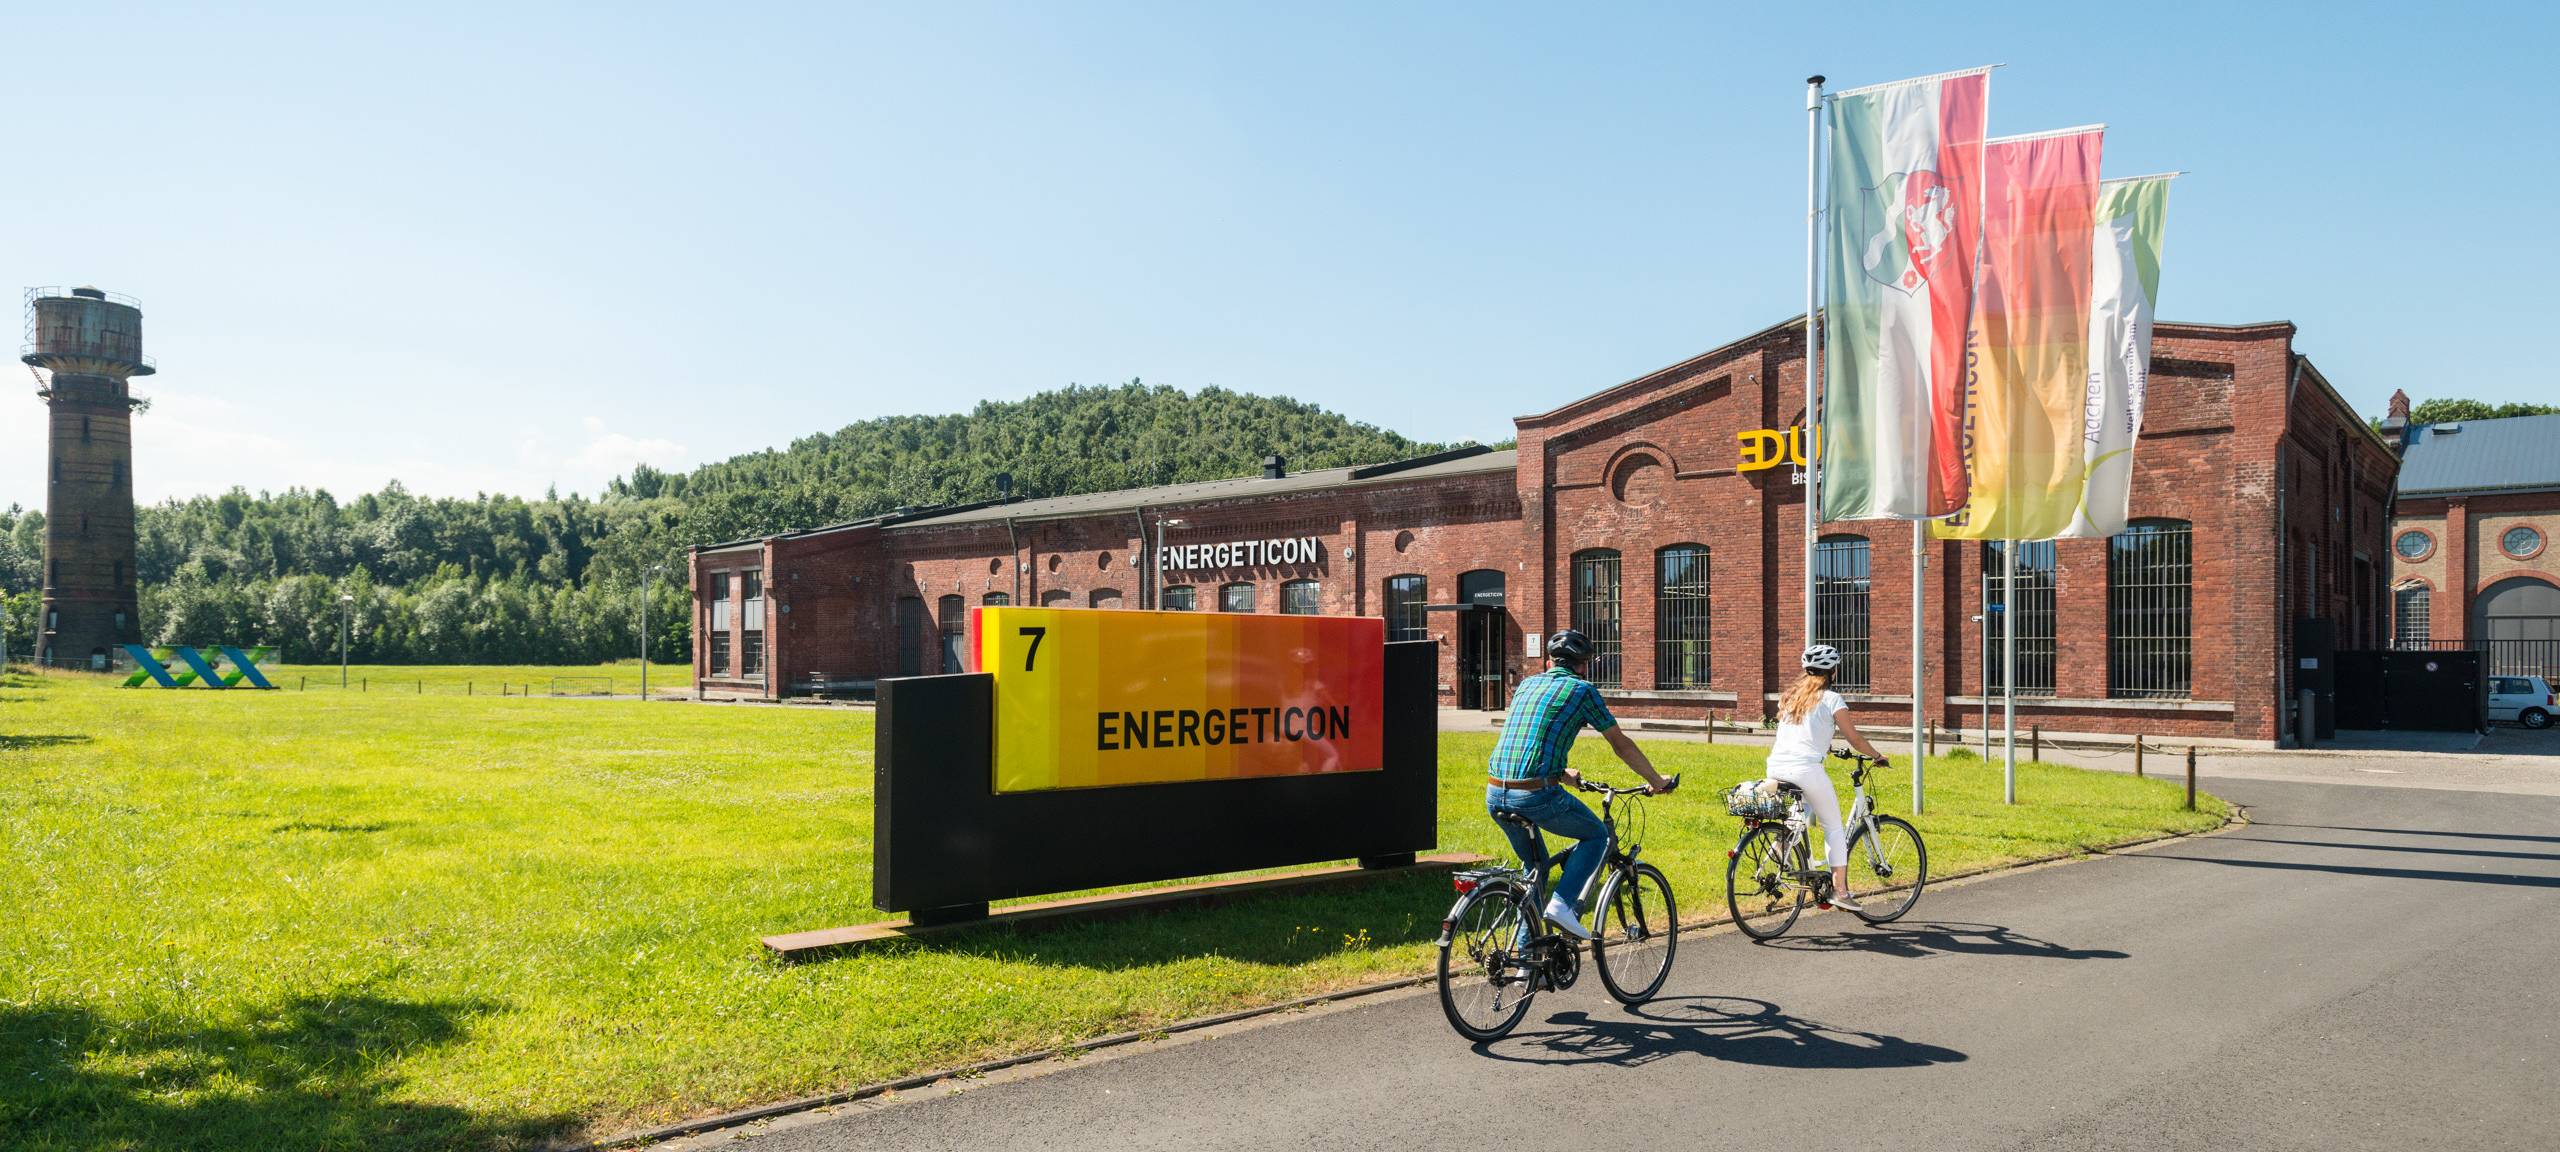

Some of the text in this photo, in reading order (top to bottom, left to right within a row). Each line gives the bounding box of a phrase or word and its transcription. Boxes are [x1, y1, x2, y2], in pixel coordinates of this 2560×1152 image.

[2084, 372, 2101, 444] Aachen
[1158, 536, 1317, 571] ENERGETICON
[1019, 627, 1046, 672] 7
[1097, 705, 1350, 751] ENERGETICON
